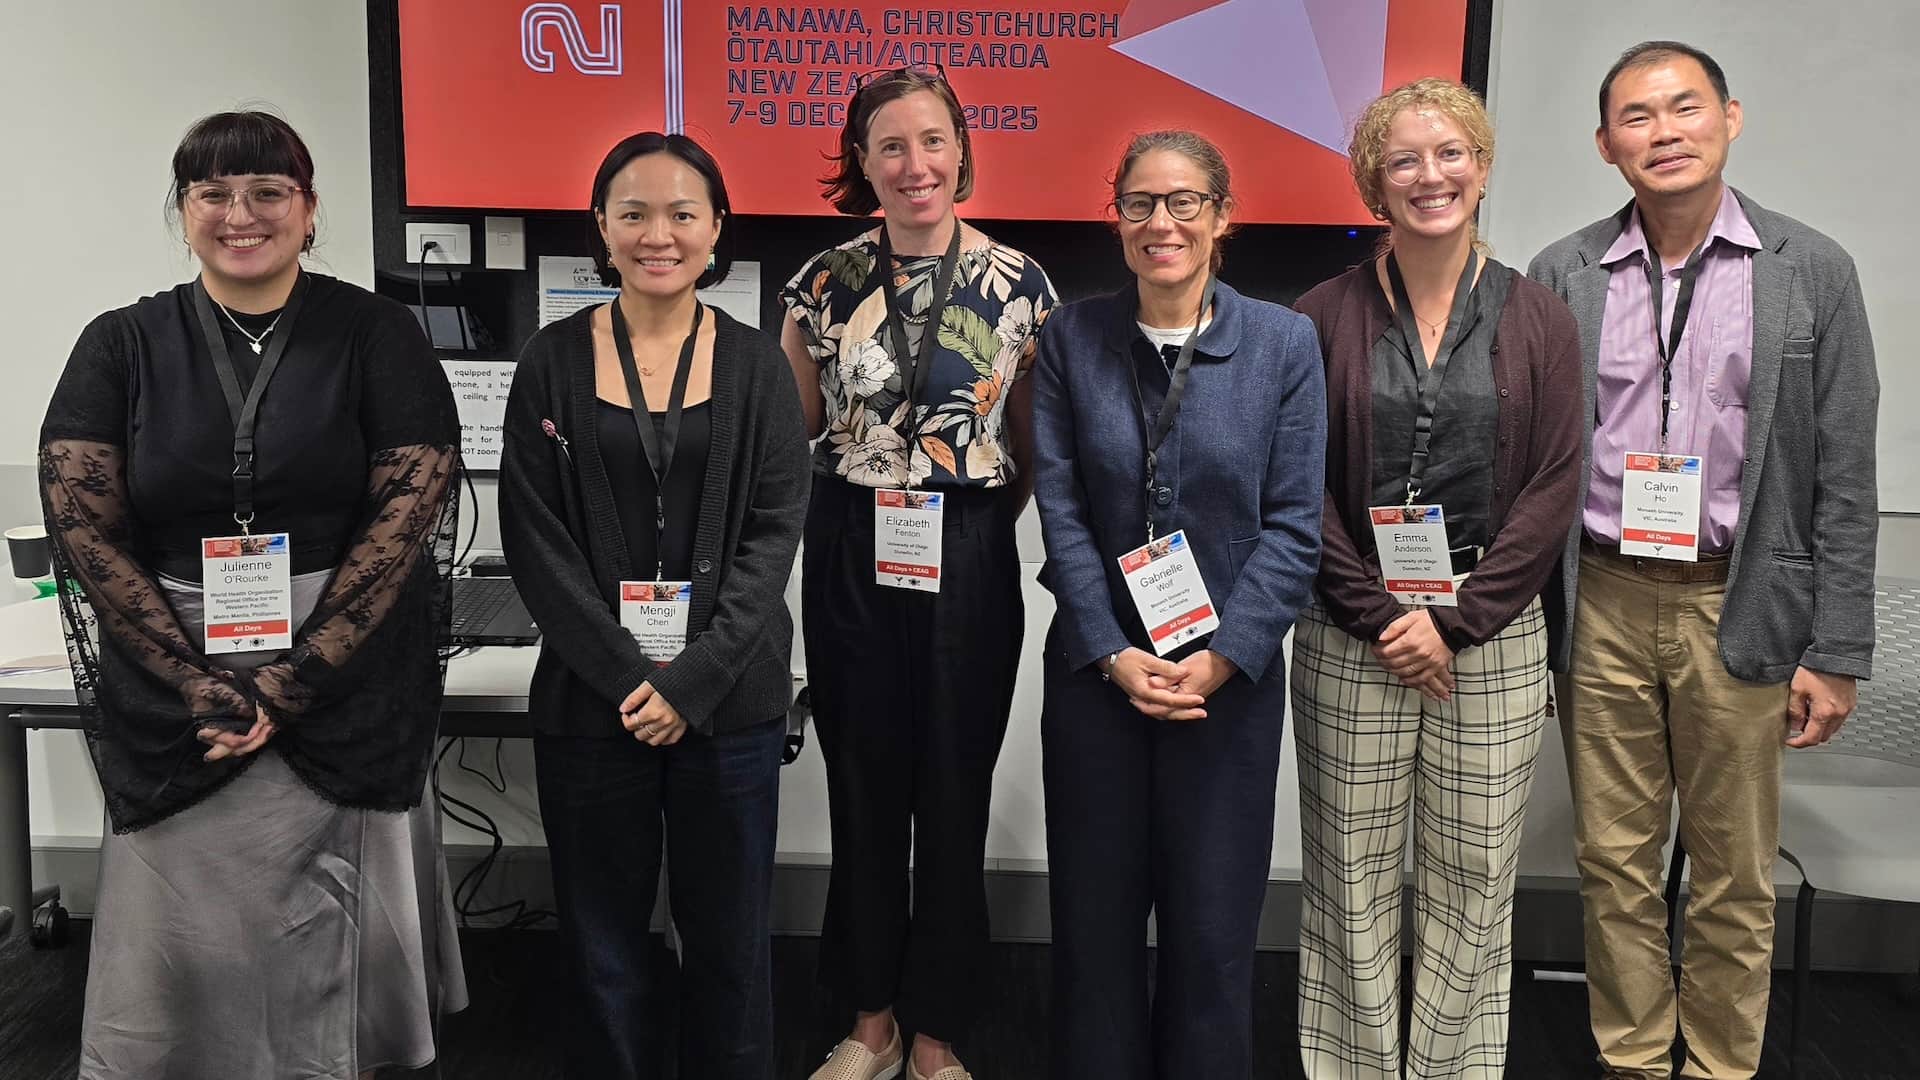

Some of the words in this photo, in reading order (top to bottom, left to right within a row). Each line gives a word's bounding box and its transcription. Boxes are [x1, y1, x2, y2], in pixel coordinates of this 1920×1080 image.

[727, 6, 872, 37] MANAWA,
[883, 10, 1120, 38] CHRISTCHURCH
[727, 32, 1050, 68] ŌTAUTAHI/AOTEAROA
[728, 69, 797, 94] NEW
[728, 100, 778, 125] 7-9
[788, 102, 846, 126] DEC
[962, 104, 1038, 130] 2025
[454, 369, 492, 377] equipped
[463, 393, 488, 401] ceiling
[1644, 480, 1679, 492] Calvin
[886, 516, 930, 528] Elizabeth
[895, 528, 920, 538] Fenton
[1394, 533, 1428, 542] Emma
[1656, 534, 1672, 542] Days
[1394, 544, 1432, 553] Anderson
[220, 560, 272, 572] Julienne
[224, 574, 269, 584] O'Rourke
[1139, 562, 1184, 588] Gabrielle
[1156, 579, 1175, 592] Wolf
[1168, 587, 1190, 600] University
[1168, 598, 1189, 608] Australia
[640, 605, 676, 618] Mengji
[1170, 621, 1178, 630] All
[1178, 616, 1191, 626] Days
